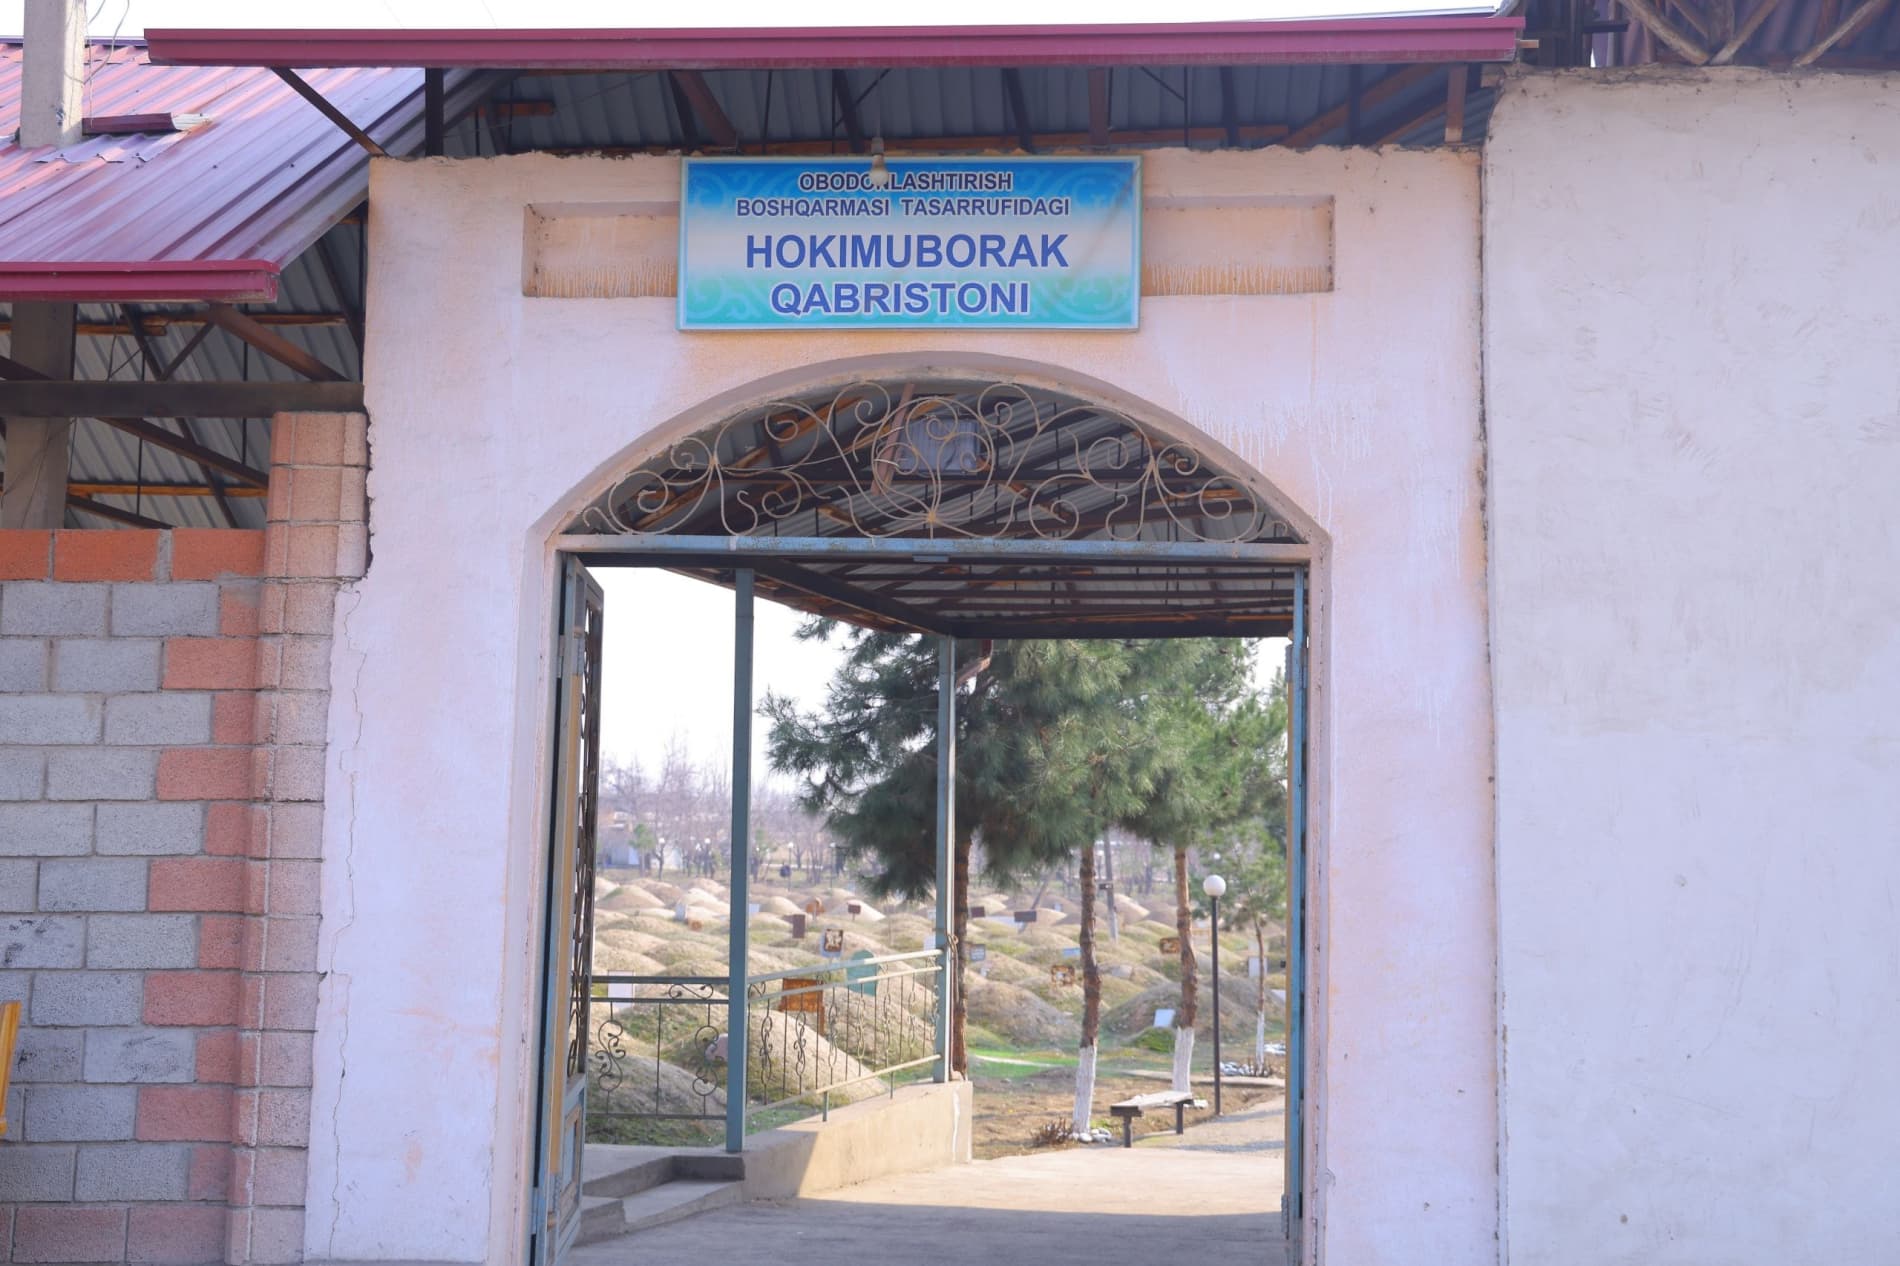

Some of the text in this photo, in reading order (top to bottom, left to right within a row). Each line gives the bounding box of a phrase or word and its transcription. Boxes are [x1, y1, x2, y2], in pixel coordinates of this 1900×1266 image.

[799, 172, 1012, 191] OBODOLASHTIRISH
[737, 198, 1069, 217] BOSHQARMASI TASARRUFIDAGI
[746, 233, 1069, 268] HOKIMUBORAK
[771, 282, 1028, 315] QABRISTONI
